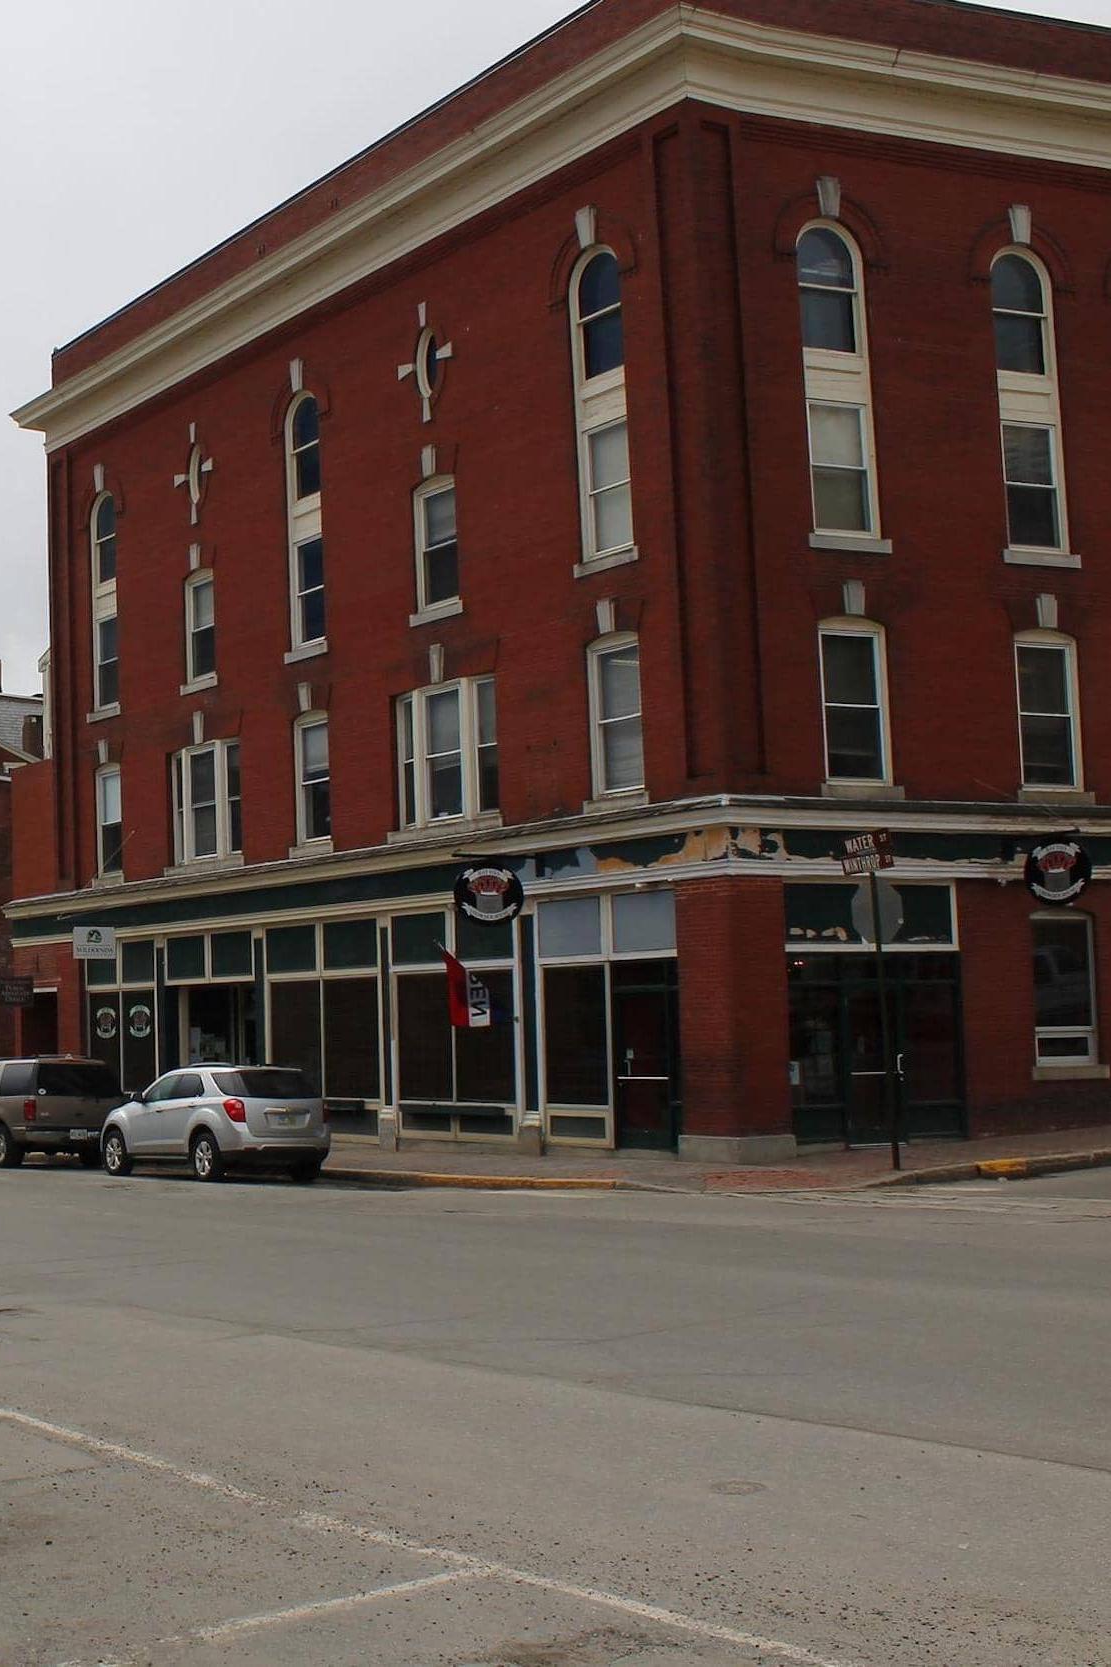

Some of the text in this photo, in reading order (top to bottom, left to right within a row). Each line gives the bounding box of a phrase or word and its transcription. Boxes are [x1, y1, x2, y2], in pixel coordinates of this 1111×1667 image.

[844, 833, 887, 853] WATER ST
[843, 854, 880, 873] WINTHROP
